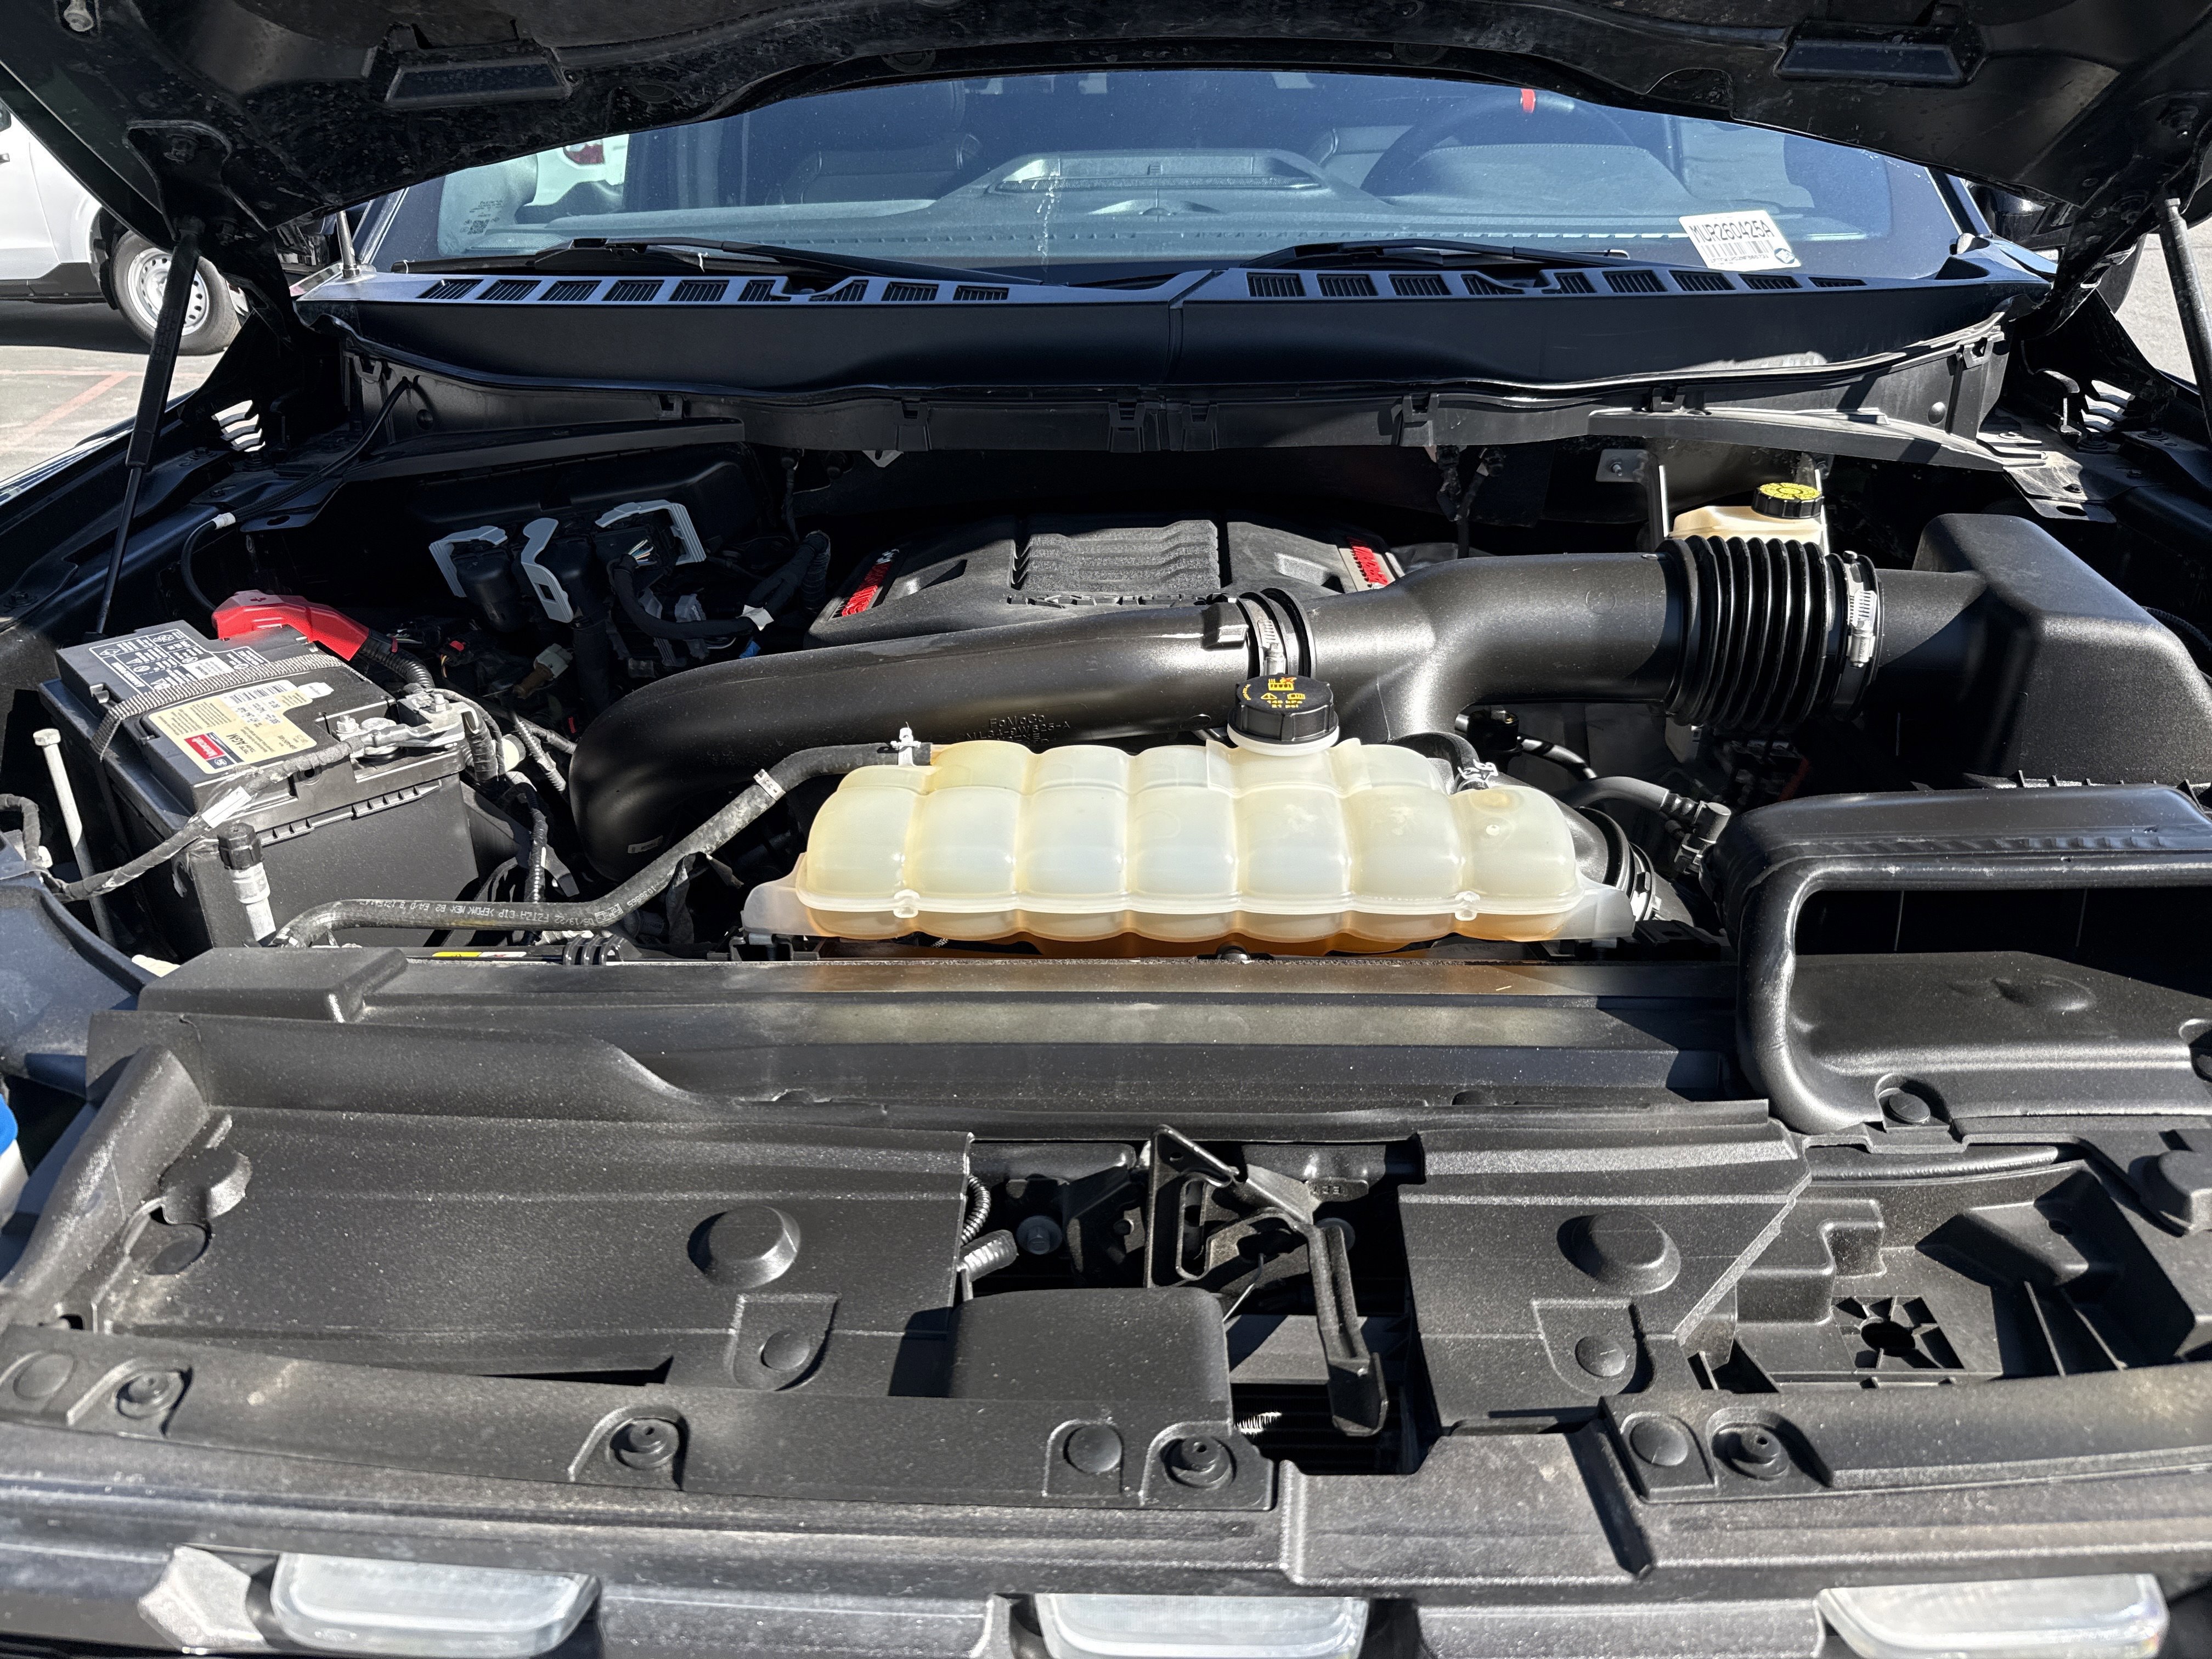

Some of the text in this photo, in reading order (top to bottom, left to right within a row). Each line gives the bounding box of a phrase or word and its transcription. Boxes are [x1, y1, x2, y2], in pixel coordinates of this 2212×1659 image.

[1689, 220, 1775, 243] MUR260425A
[989, 713, 1046, 727] FoMoCo
[191, 736, 218, 757] Motorcraft
[225, 733, 247, 744] AGM
[627, 885, 657, 908] 1036865
[435, 904, 447, 912] B2
